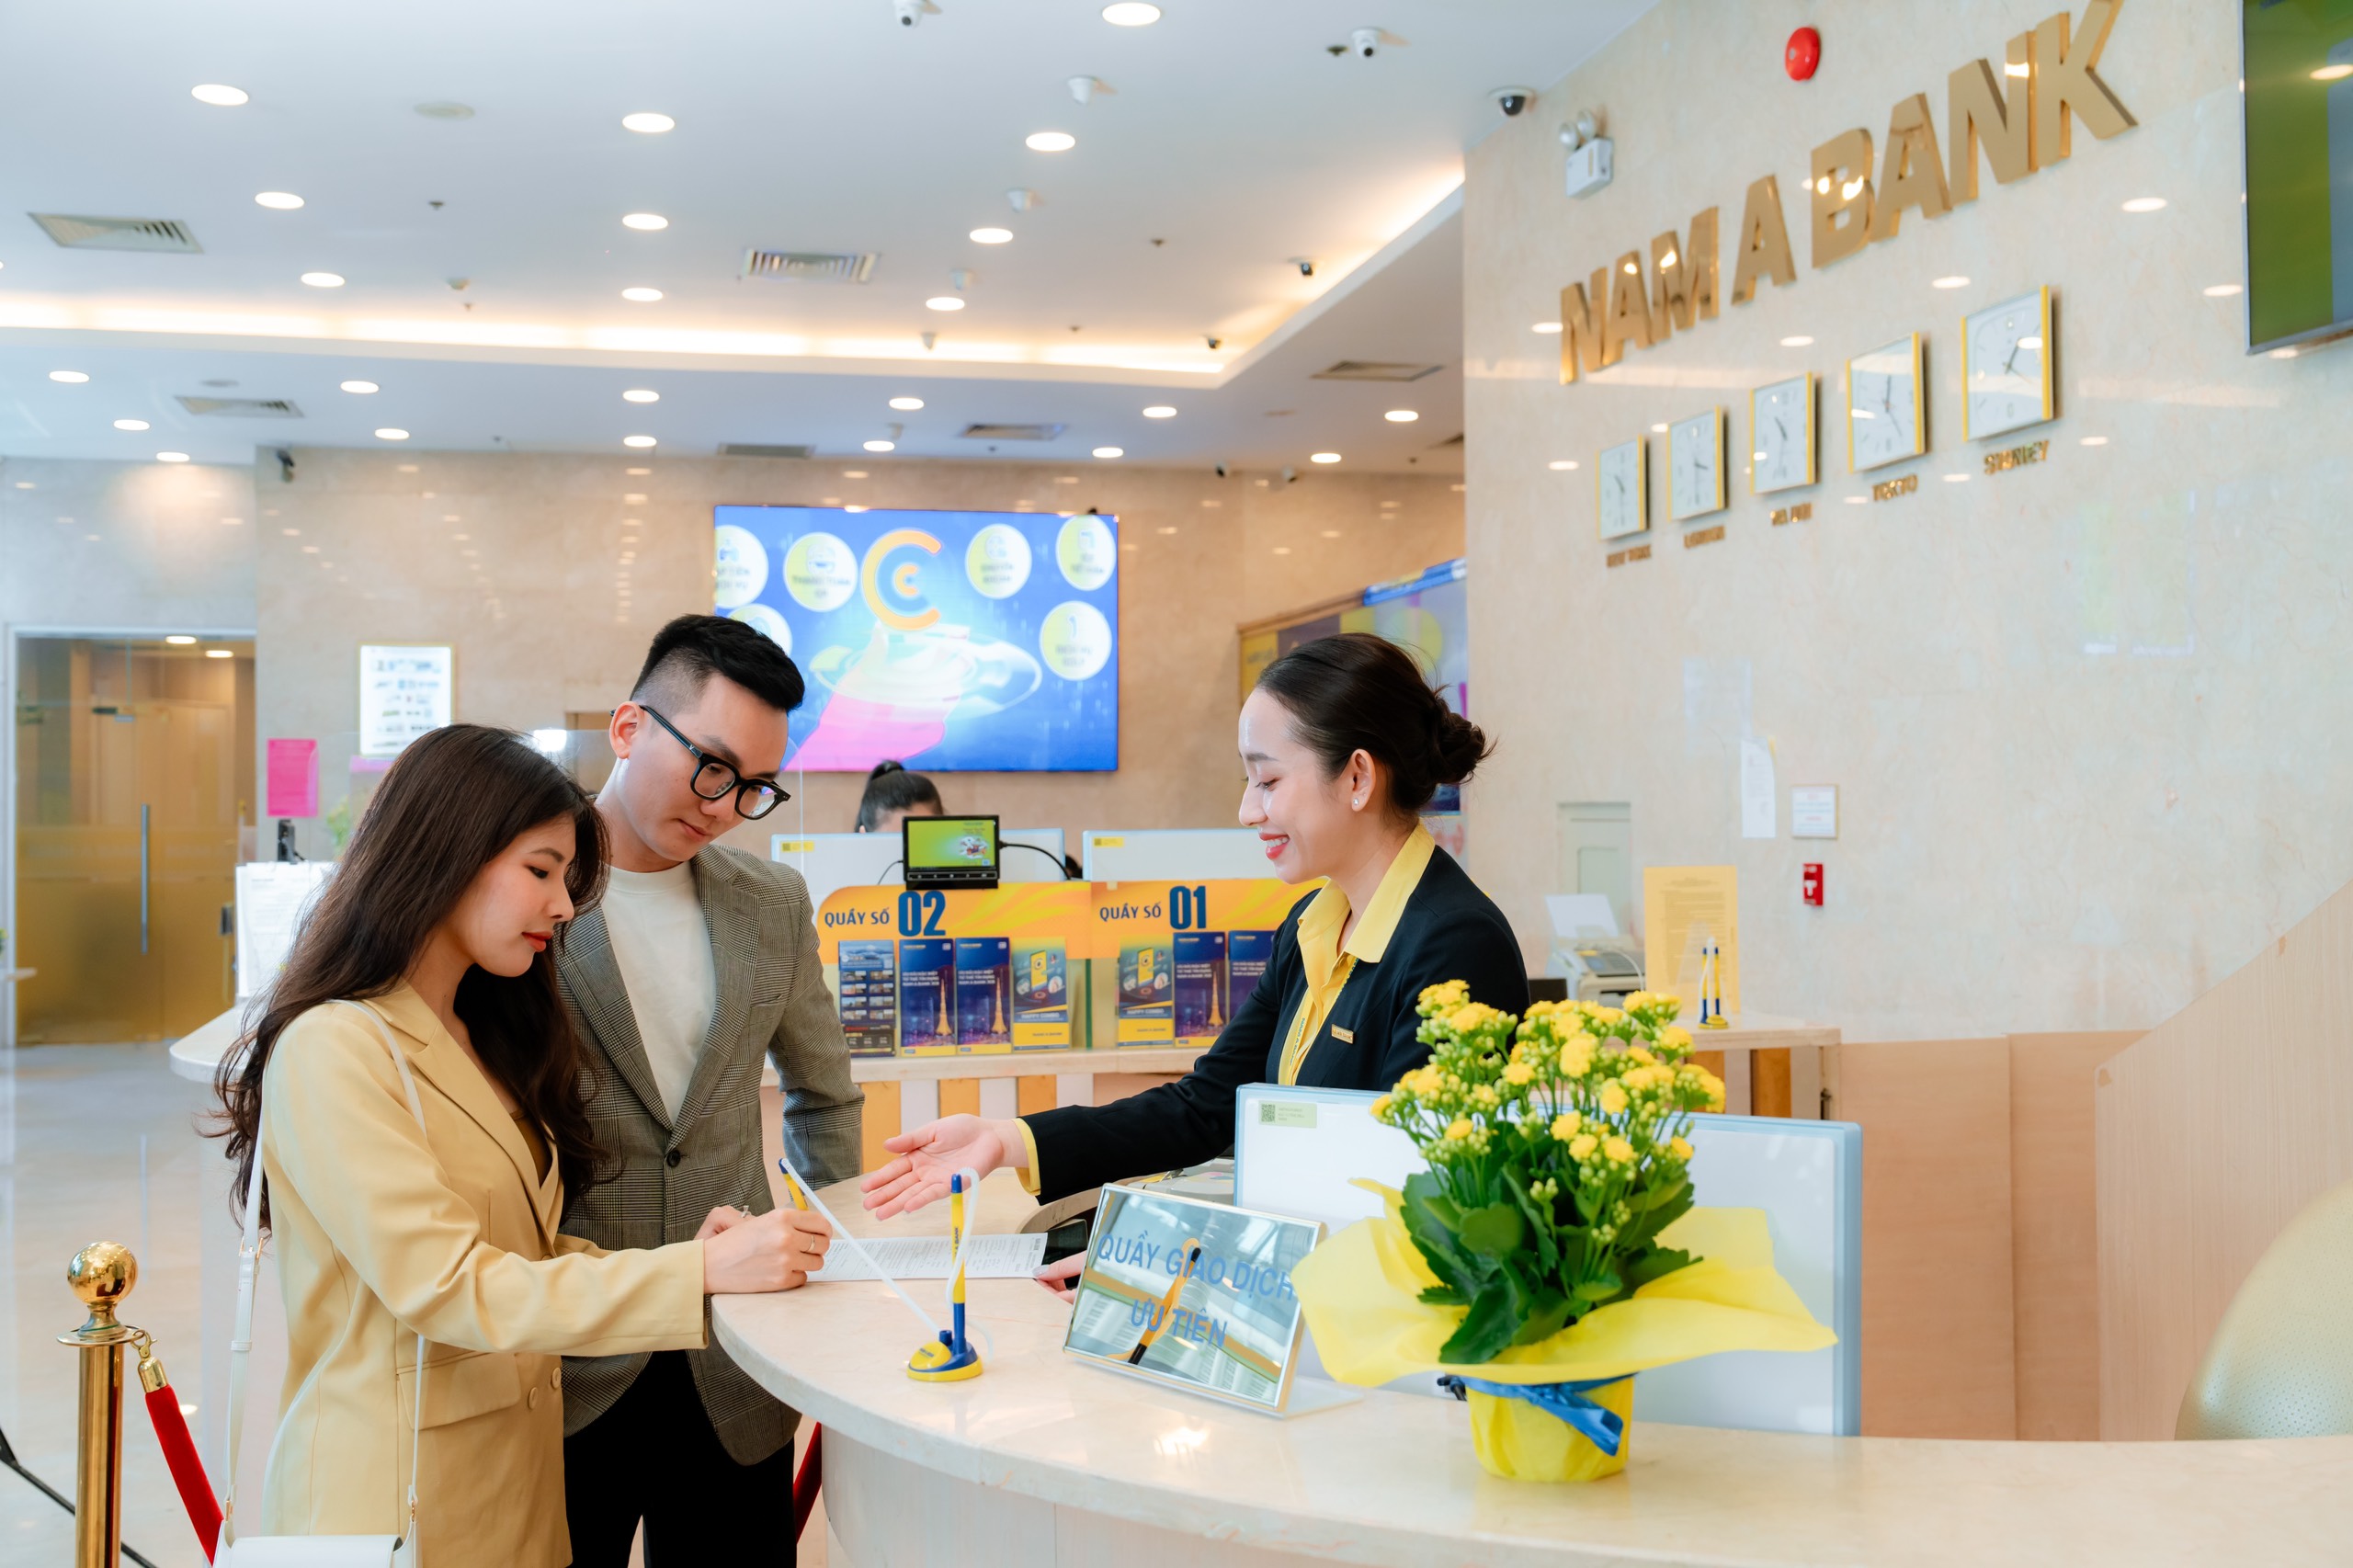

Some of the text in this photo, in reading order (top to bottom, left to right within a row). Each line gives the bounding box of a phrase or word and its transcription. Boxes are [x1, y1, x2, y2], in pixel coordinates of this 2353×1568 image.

[1560, 0, 2139, 385] NAM A BANK
[870, 906, 891, 926] SỐ
[898, 890, 947, 937] 02
[1143, 901, 1162, 919] SỐ
[1169, 885, 1207, 930] 01
[1097, 1230, 1294, 1301] QUẦY GIAO DỊCH
[1131, 1298, 1228, 1348] ƯU TIÊN
